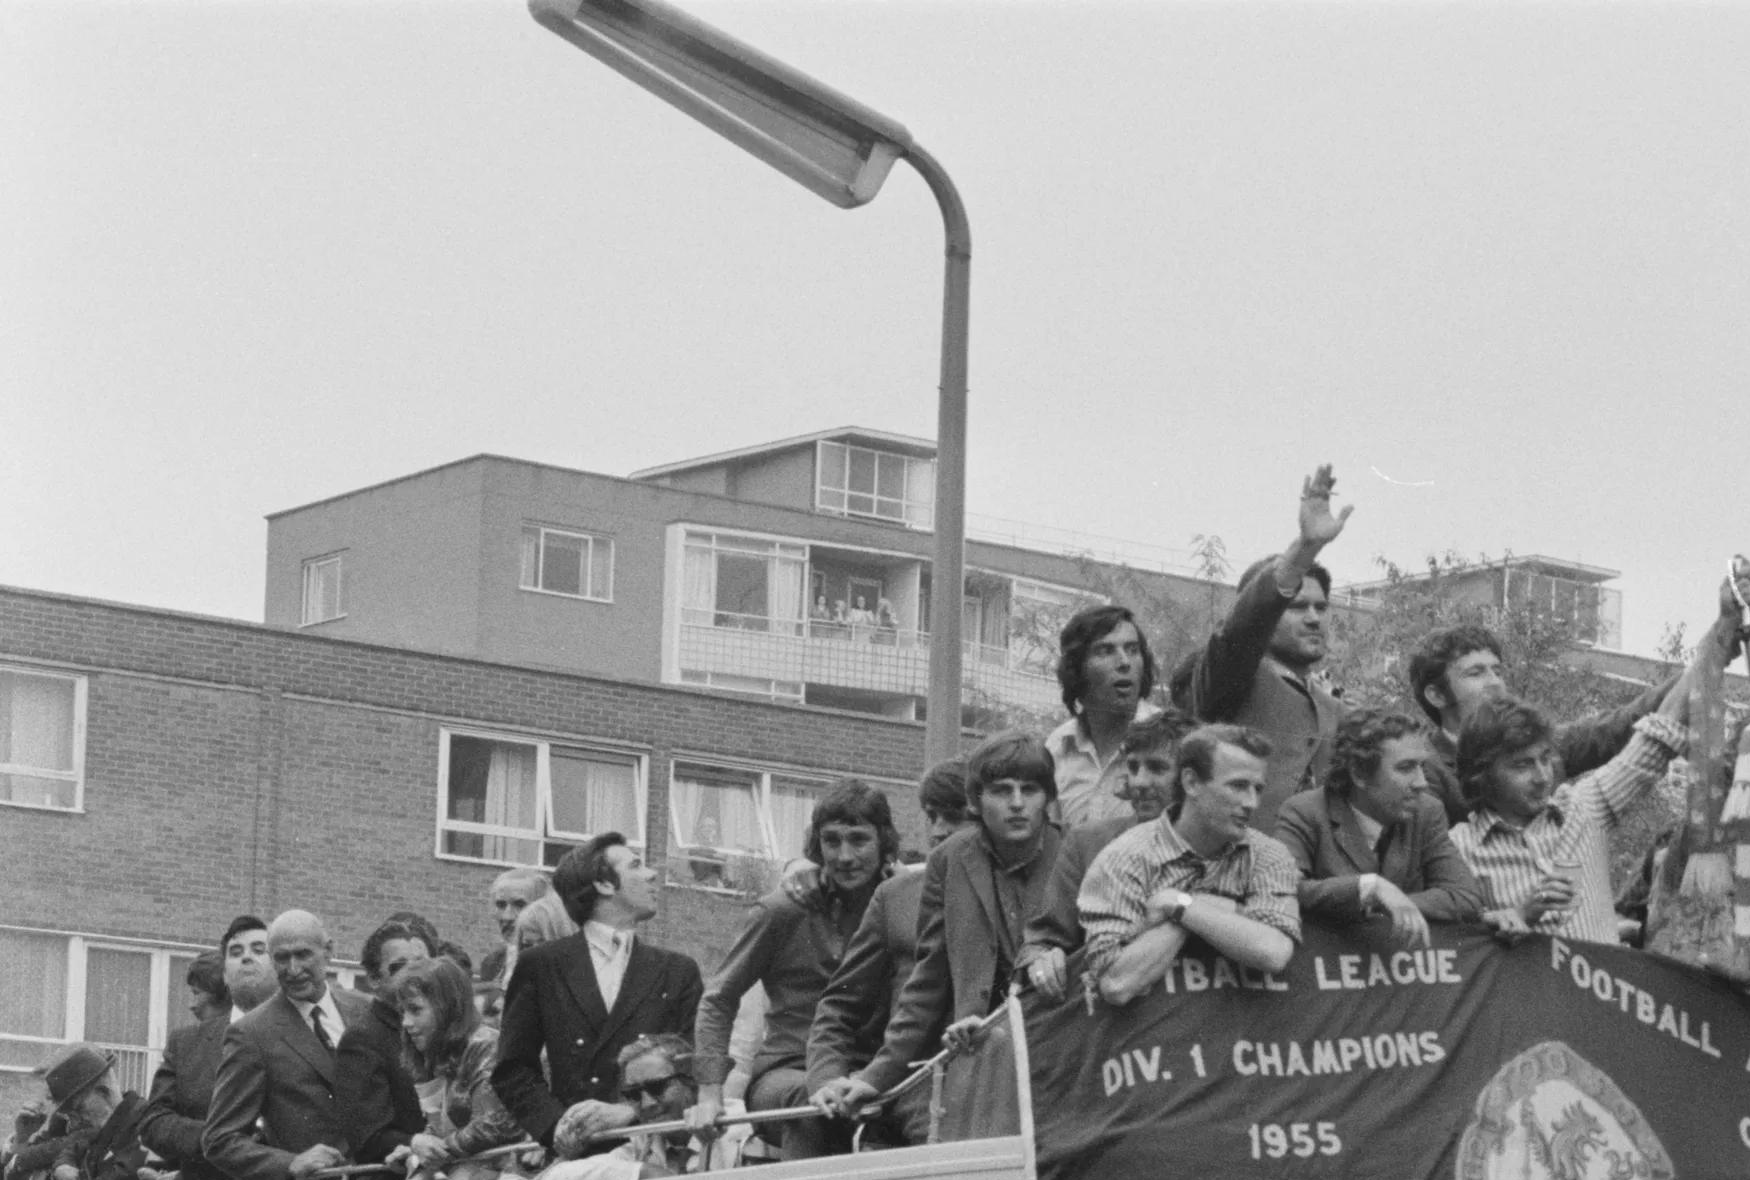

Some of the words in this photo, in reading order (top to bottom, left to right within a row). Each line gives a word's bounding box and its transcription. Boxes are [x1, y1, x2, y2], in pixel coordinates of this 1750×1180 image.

[1163, 956, 1289, 994] TBALL
[1314, 948, 1463, 990] LEAGUE
[1551, 936, 1723, 1059] FOOTBALL
[1102, 1045, 1173, 1098] DIV.
[1189, 1043, 1207, 1078] 1
[1232, 1030, 1447, 1077] CHAMPIONS
[1249, 1121, 1344, 1160] 1955
